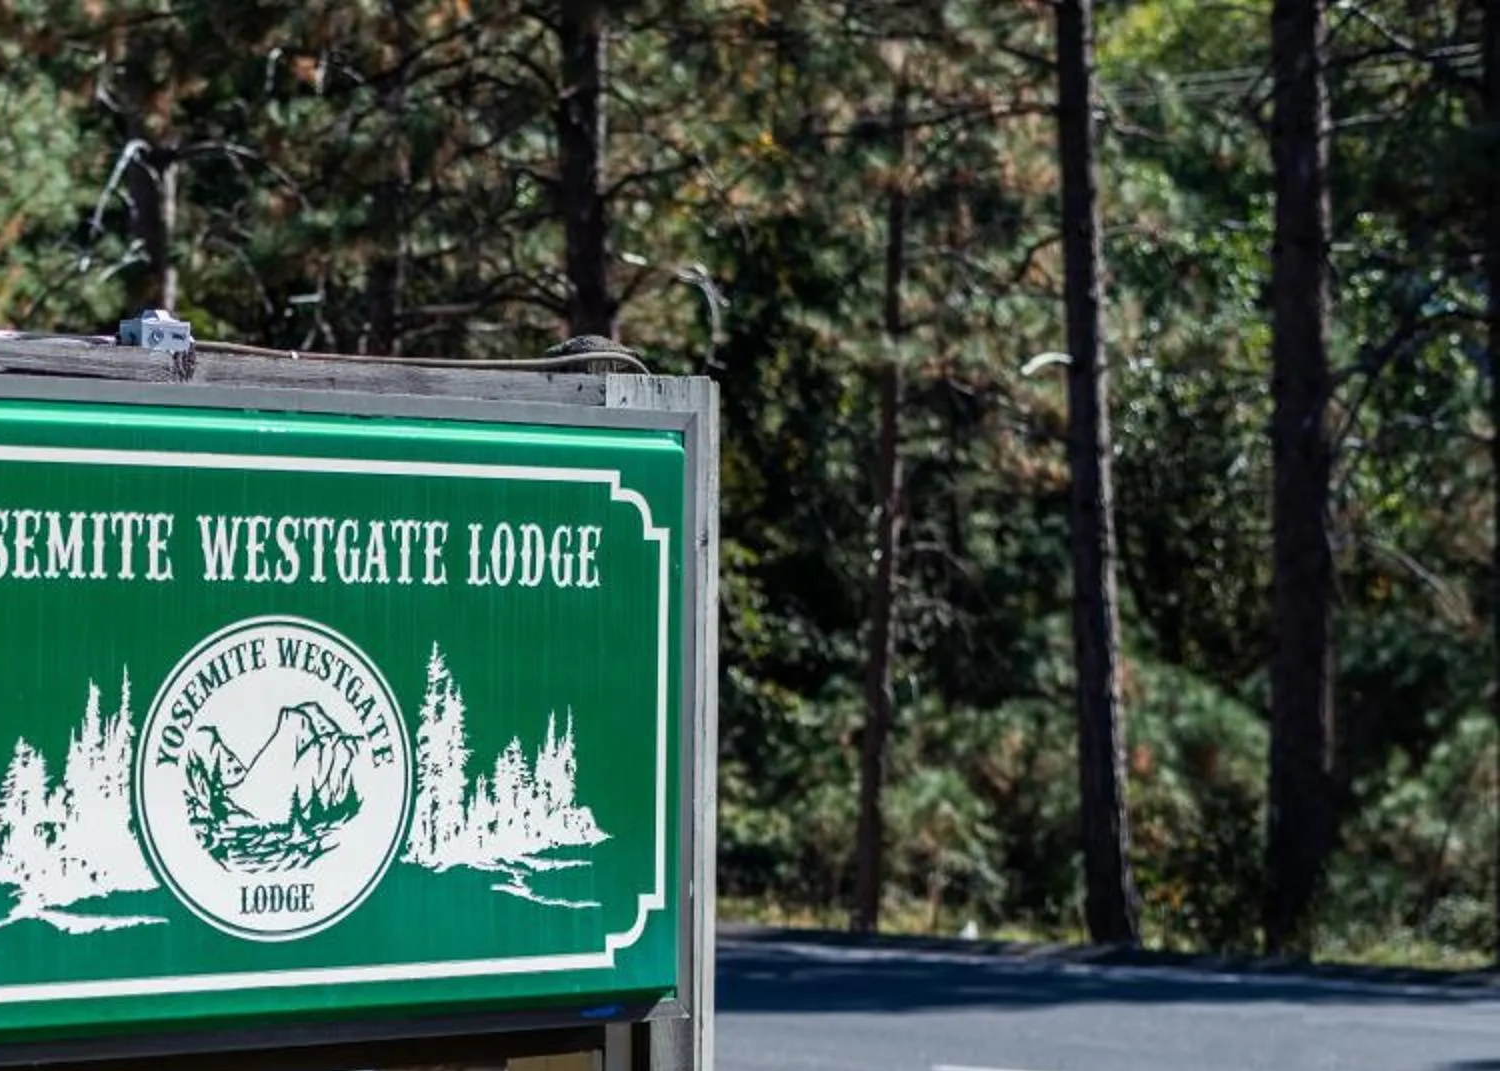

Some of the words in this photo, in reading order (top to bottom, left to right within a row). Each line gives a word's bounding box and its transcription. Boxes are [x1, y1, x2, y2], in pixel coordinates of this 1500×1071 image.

[196, 514, 449, 585] WESTGATE
[467, 522, 603, 588] LODGE
[156, 638, 267, 768] YOSEMITE
[276, 637, 395, 768] WESTGATE
[239, 883, 315, 914] LODGE
